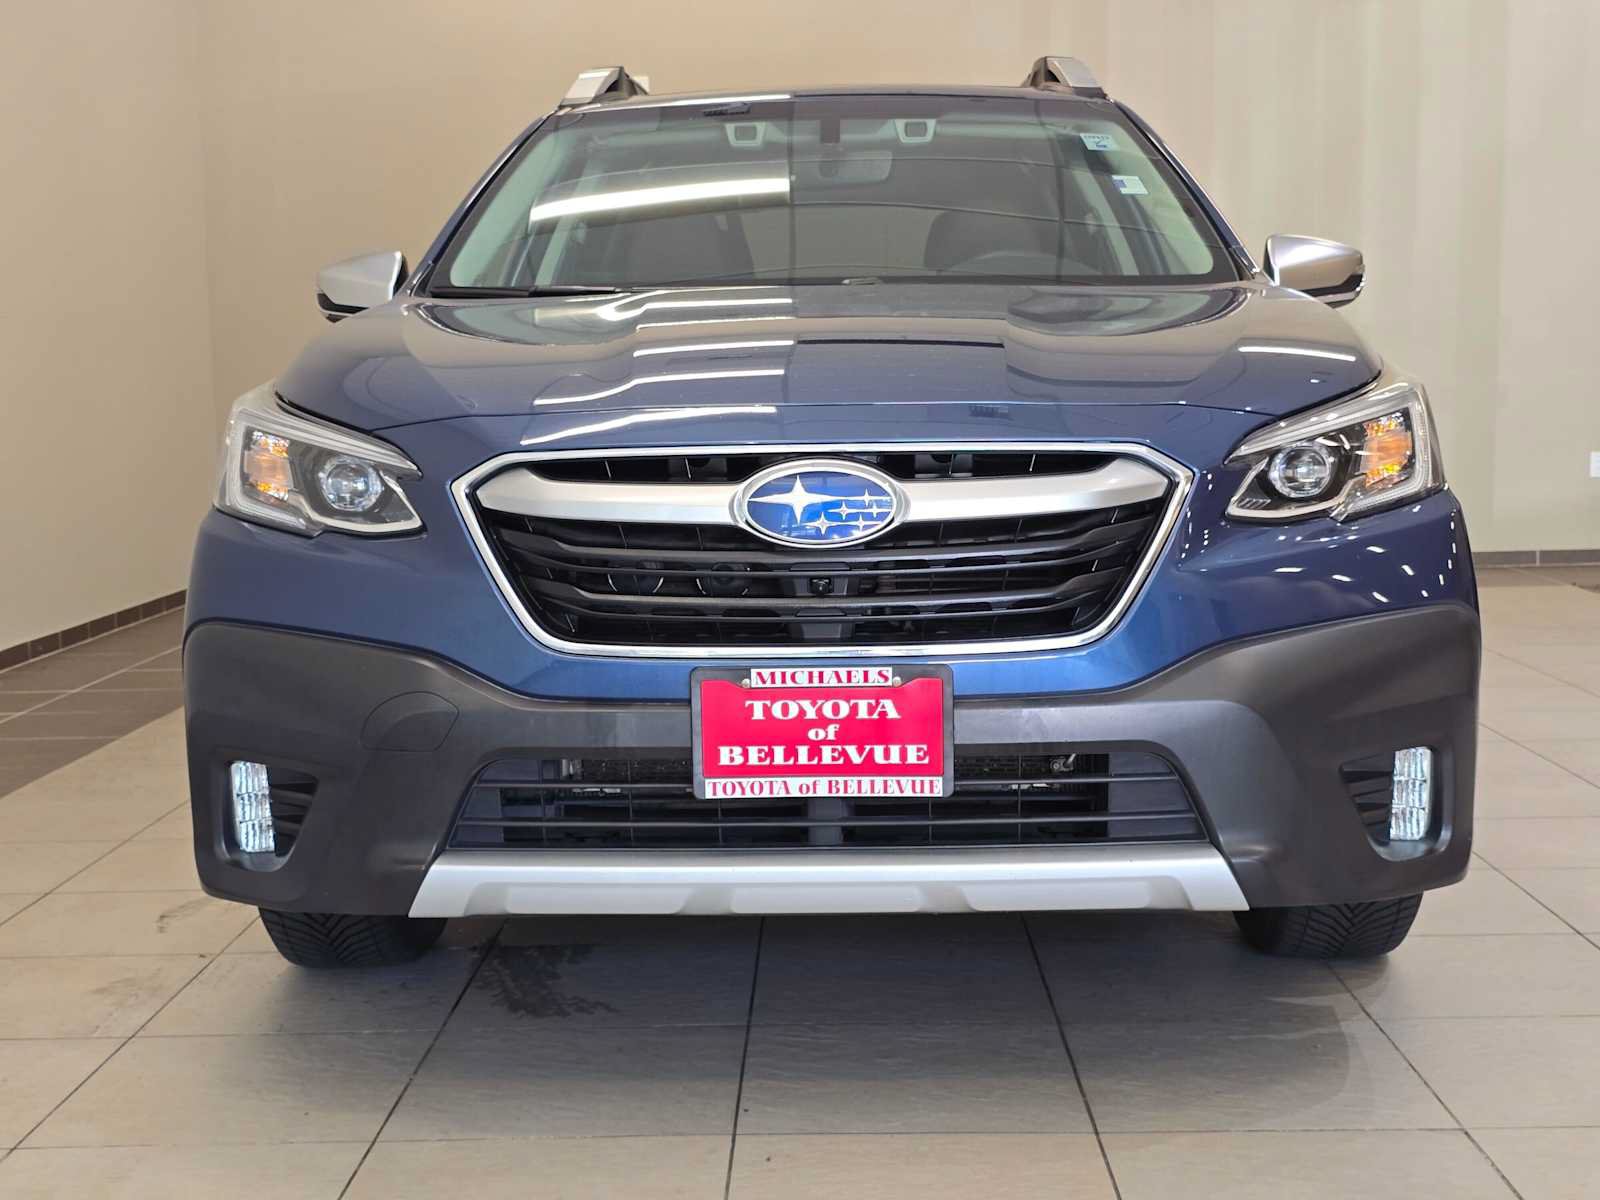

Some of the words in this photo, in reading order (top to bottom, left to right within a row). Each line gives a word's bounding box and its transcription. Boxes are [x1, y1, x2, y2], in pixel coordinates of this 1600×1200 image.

[755, 669, 890, 686] MICHAELS
[745, 699, 901, 720] TOYOTA
[807, 724, 840, 741] of
[718, 744, 929, 766] BELLEVUE
[707, 780, 791, 797] TOYOTA
[798, 779, 821, 795] of
[828, 778, 941, 795] BELLEVUE
